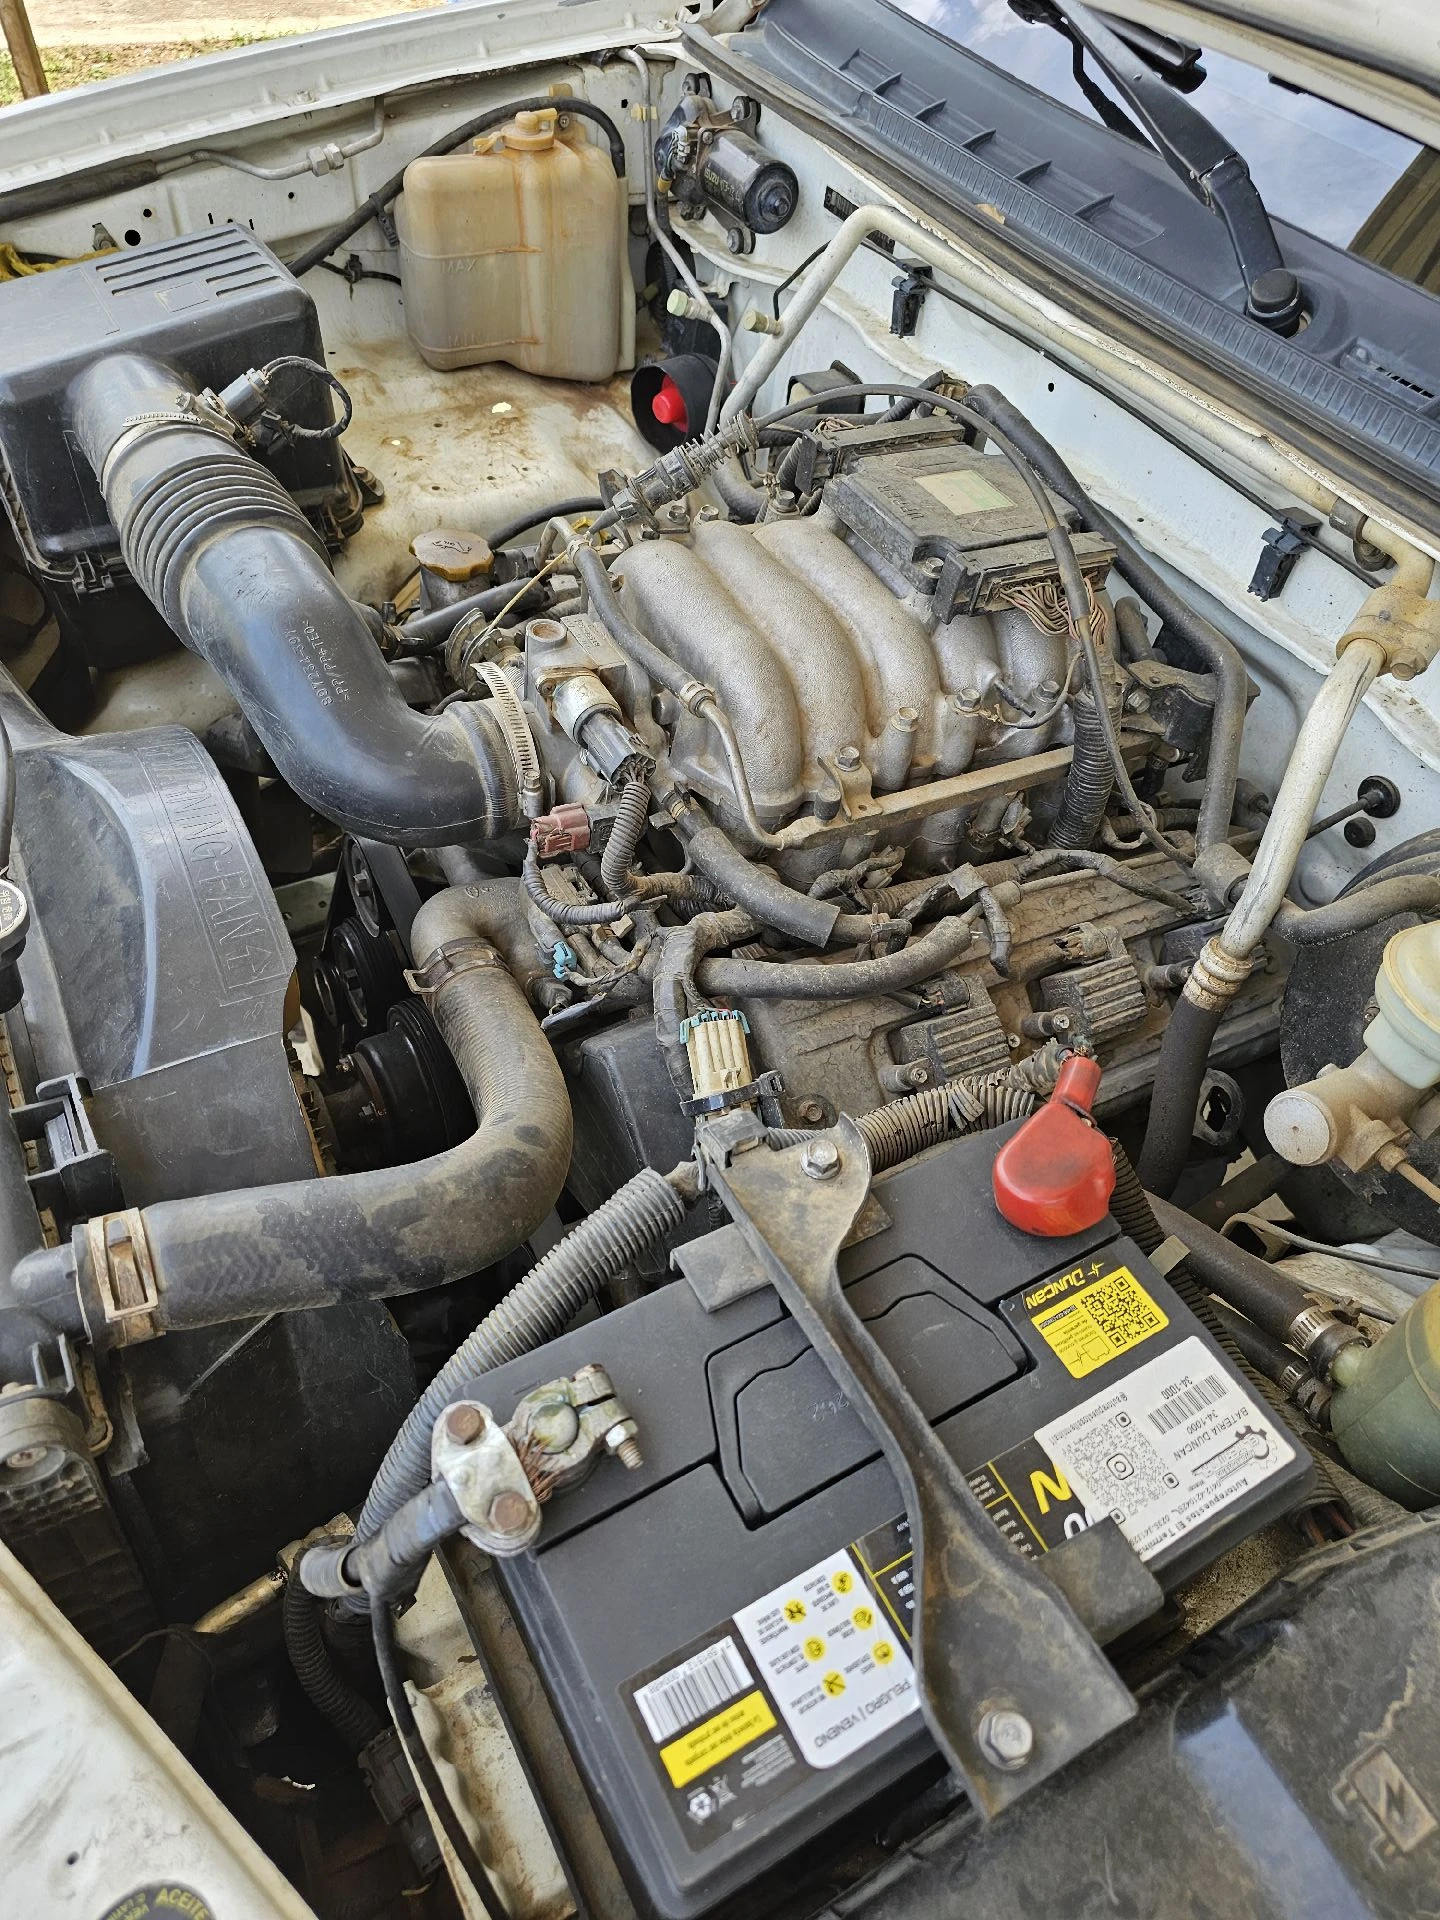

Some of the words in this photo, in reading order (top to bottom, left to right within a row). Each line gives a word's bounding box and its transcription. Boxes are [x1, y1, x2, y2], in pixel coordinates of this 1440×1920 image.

[440, 257, 478, 272] MAX
[1026, 1268, 1086, 1309] DUNCAN
[1160, 1374, 1192, 1400] 34-1000
[1184, 1408, 1218, 1435] 34-1000
[1211, 1406, 1249, 1436] BATERIA
[1172, 1432, 1210, 1460] DUNCAN
[1185, 1478, 1248, 1522] Autorepuestos
[865, 1680, 911, 1714] PELIGRO
[813, 1714, 859, 1748] VENENO
